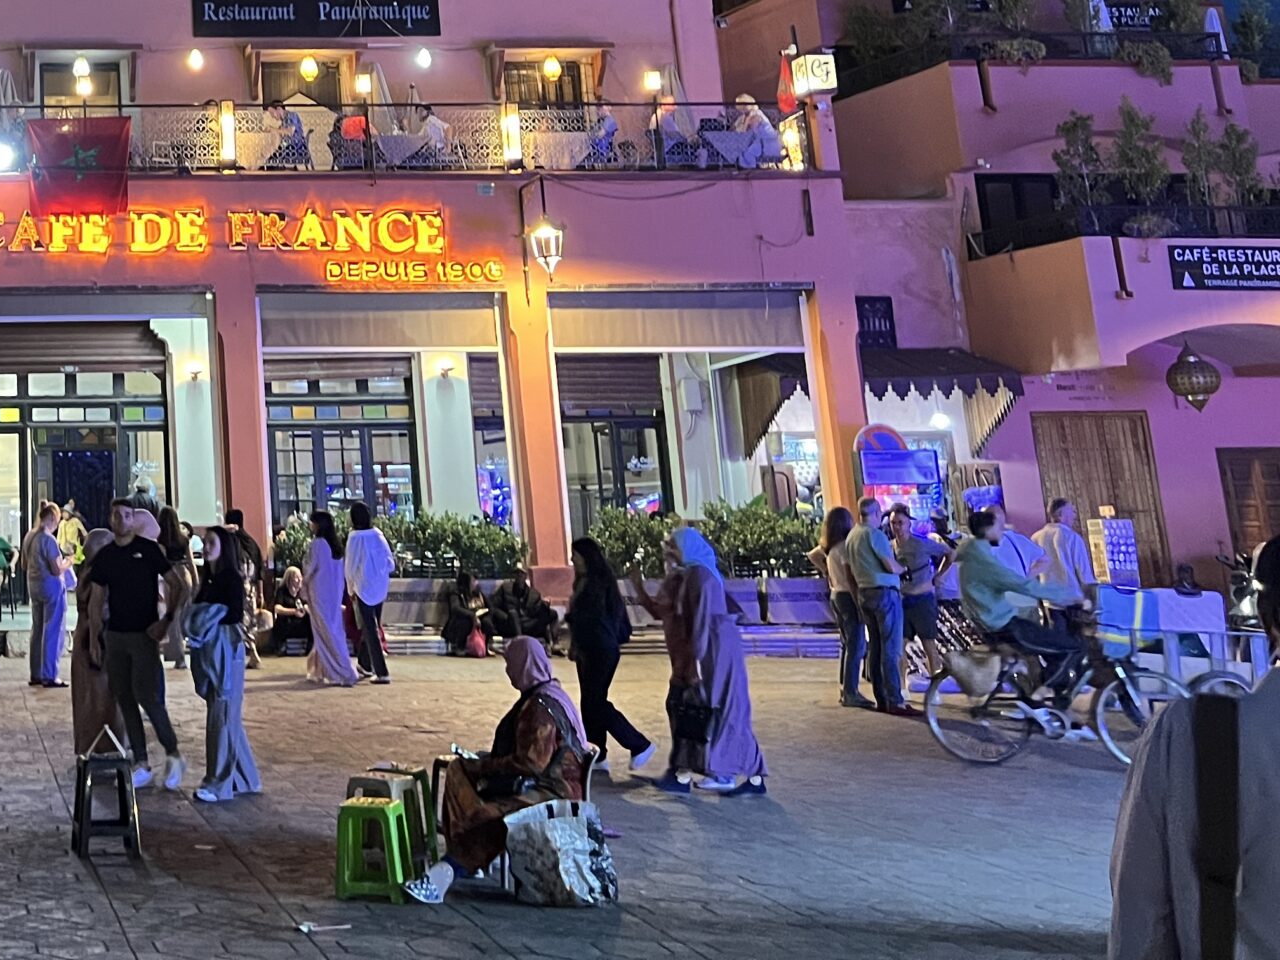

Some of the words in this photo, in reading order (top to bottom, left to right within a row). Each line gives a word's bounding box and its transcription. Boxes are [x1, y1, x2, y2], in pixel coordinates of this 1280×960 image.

[203, 1, 296, 22] Restaurant
[319, 1, 431, 28] Panoramique
[129, 209, 208, 253] DE
[226, 208, 445, 255] FRANCE
[325, 259, 428, 281] DEPUIS
[1202, 264, 1220, 276] DE
[1223, 264, 1241, 276] LA
